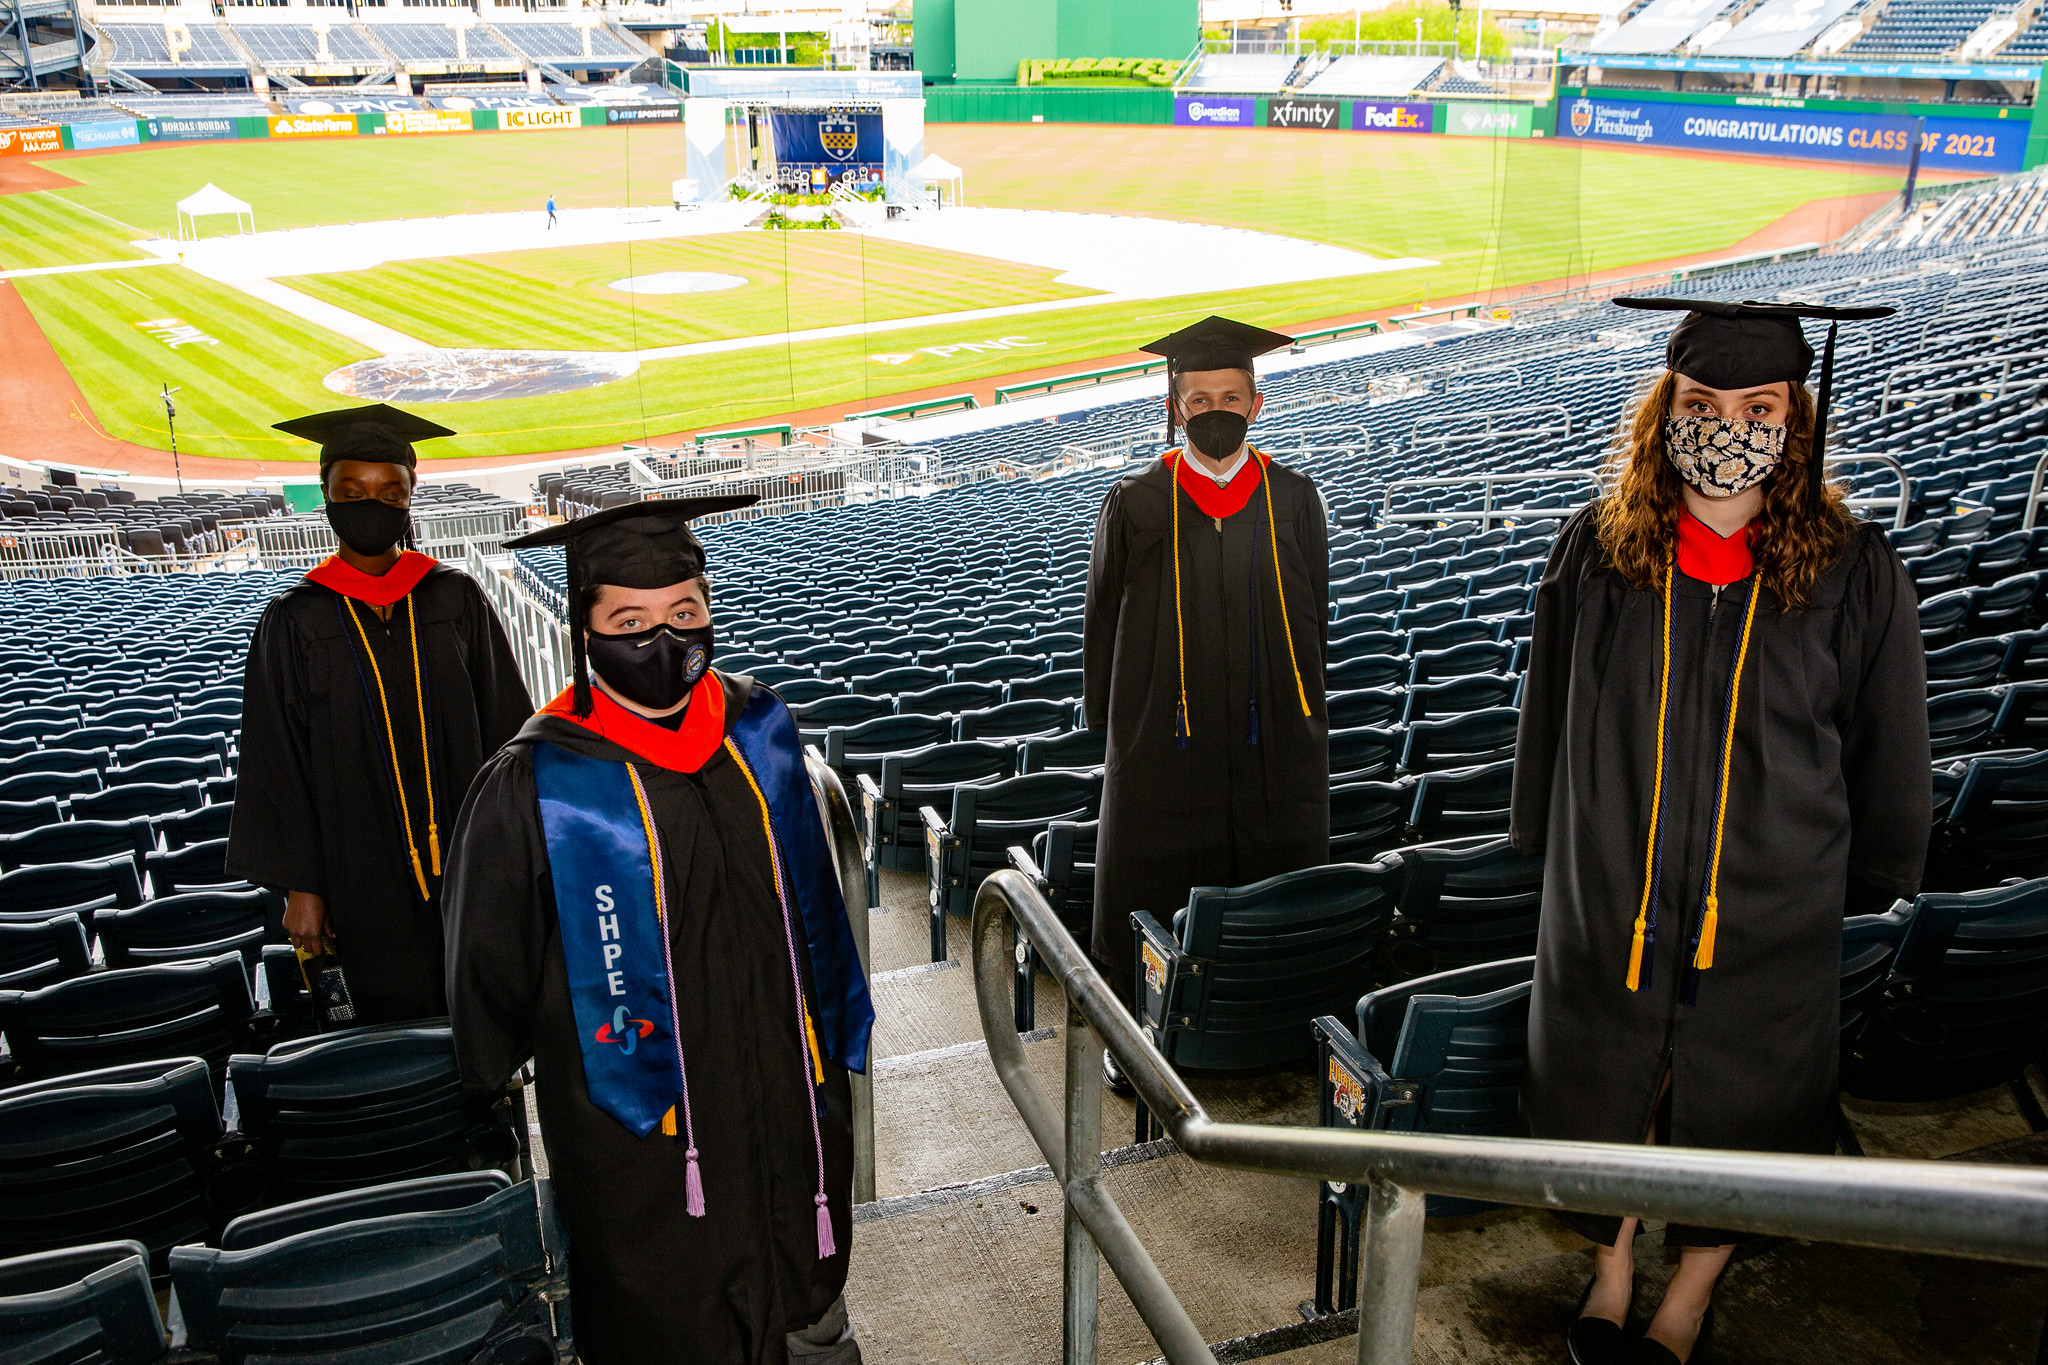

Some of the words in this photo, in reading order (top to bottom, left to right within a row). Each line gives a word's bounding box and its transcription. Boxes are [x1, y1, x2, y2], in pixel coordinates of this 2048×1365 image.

[460, 64, 482, 72] LIGHT
[336, 99, 414, 113] PNC
[476, 97, 549, 107] PNC
[619, 110, 638, 120] AT&T
[637, 109, 680, 119] SPORTSNET
[1189, 102, 1241, 119] Guardian
[1273, 101, 1335, 128] xfinity
[1365, 106, 1420, 127] FedEx
[1595, 105, 1632, 121] University
[1631, 107, 1642, 119] of
[161, 120, 196, 133] BORDAS
[196, 120, 231, 132] BORDAS
[506, 111, 525, 127] IC
[528, 111, 573, 125] LIGHT
[1481, 113, 1518, 129] AHN
[19, 129, 57, 141] Insurance
[1593, 117, 1654, 142] Pittsburgh
[1683, 117, 1844, 147] CONGRATULATIONS
[1847, 127, 1908, 151] CLASS
[1944, 133, 1996, 157] 2021
[23, 141, 60, 153] AAA.com
[917, 335, 1048, 358] PNC
[595, 884, 627, 997] SHPE
[1142, 943, 1166, 986] PIRATES
[1329, 1057, 1363, 1114] PIRATES
